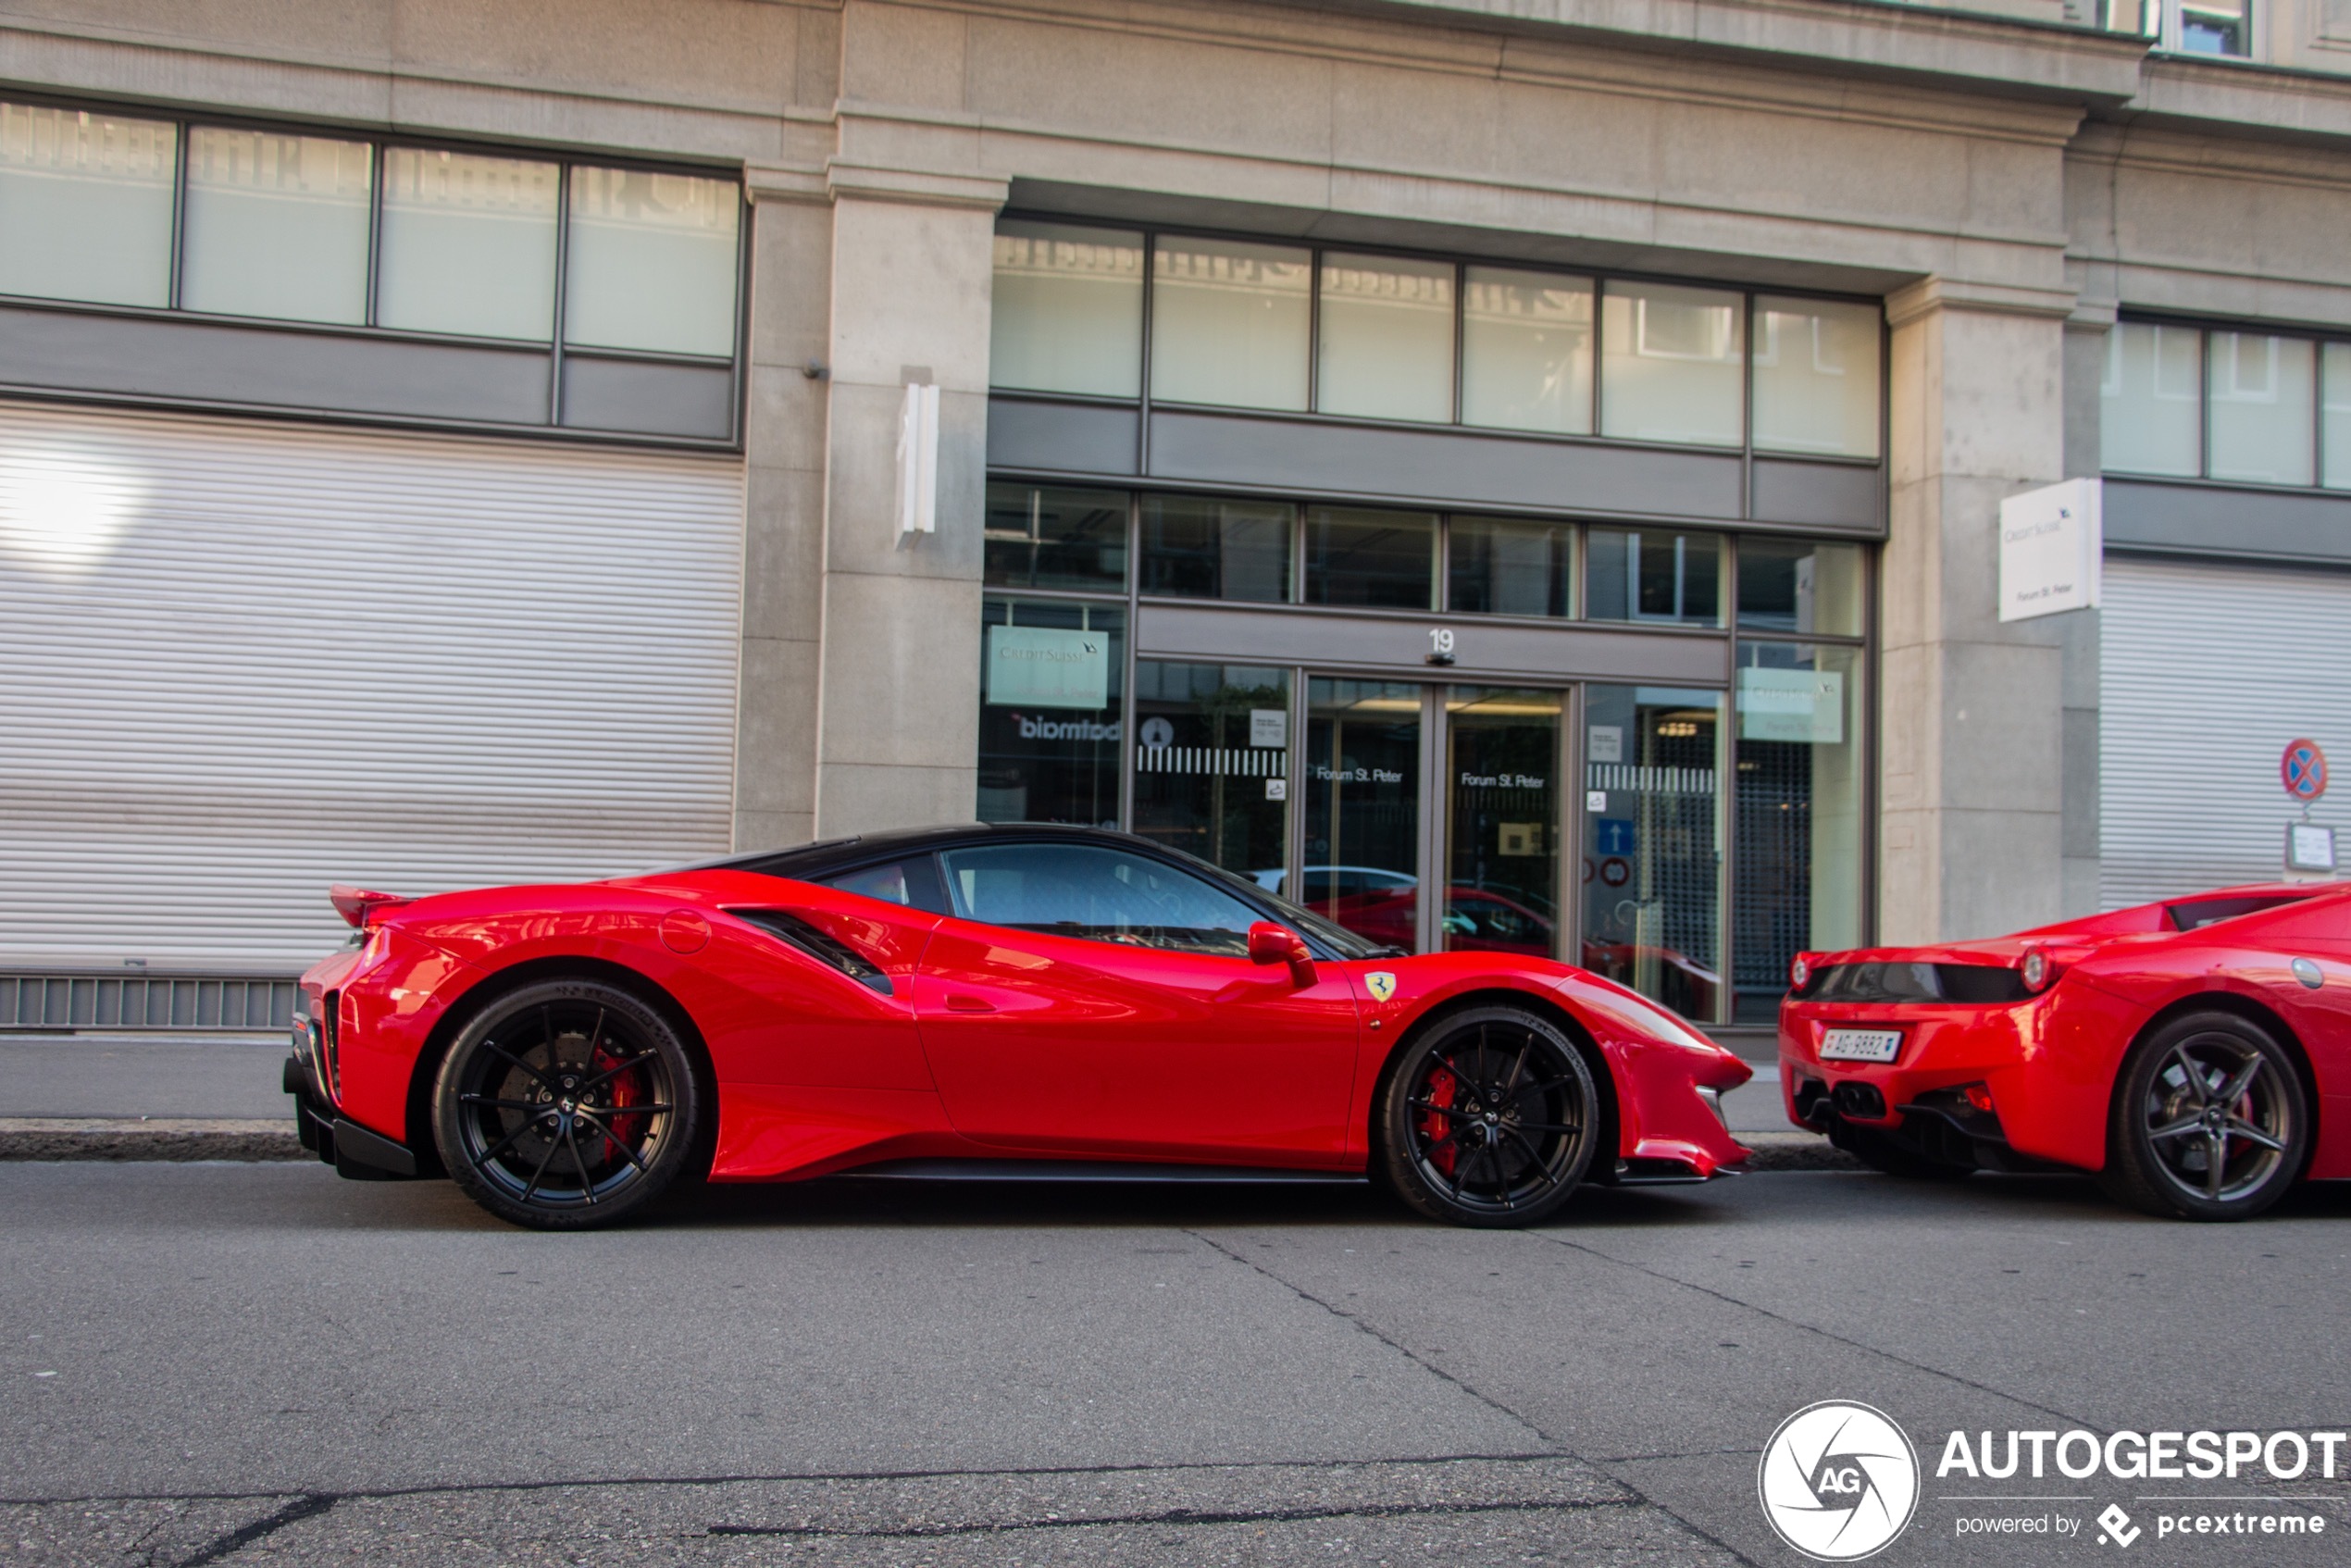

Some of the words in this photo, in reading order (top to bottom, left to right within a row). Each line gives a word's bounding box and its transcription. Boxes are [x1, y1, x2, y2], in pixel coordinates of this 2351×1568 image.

[1429, 628, 1454, 653] 19
[1317, 766, 1353, 781] Forum
[1354, 767, 1371, 782] St.
[1373, 768, 1402, 783] Peter
[1462, 772, 1497, 787] Forum
[1499, 773, 1513, 788] St.
[1515, 774, 1545, 789] Peter
